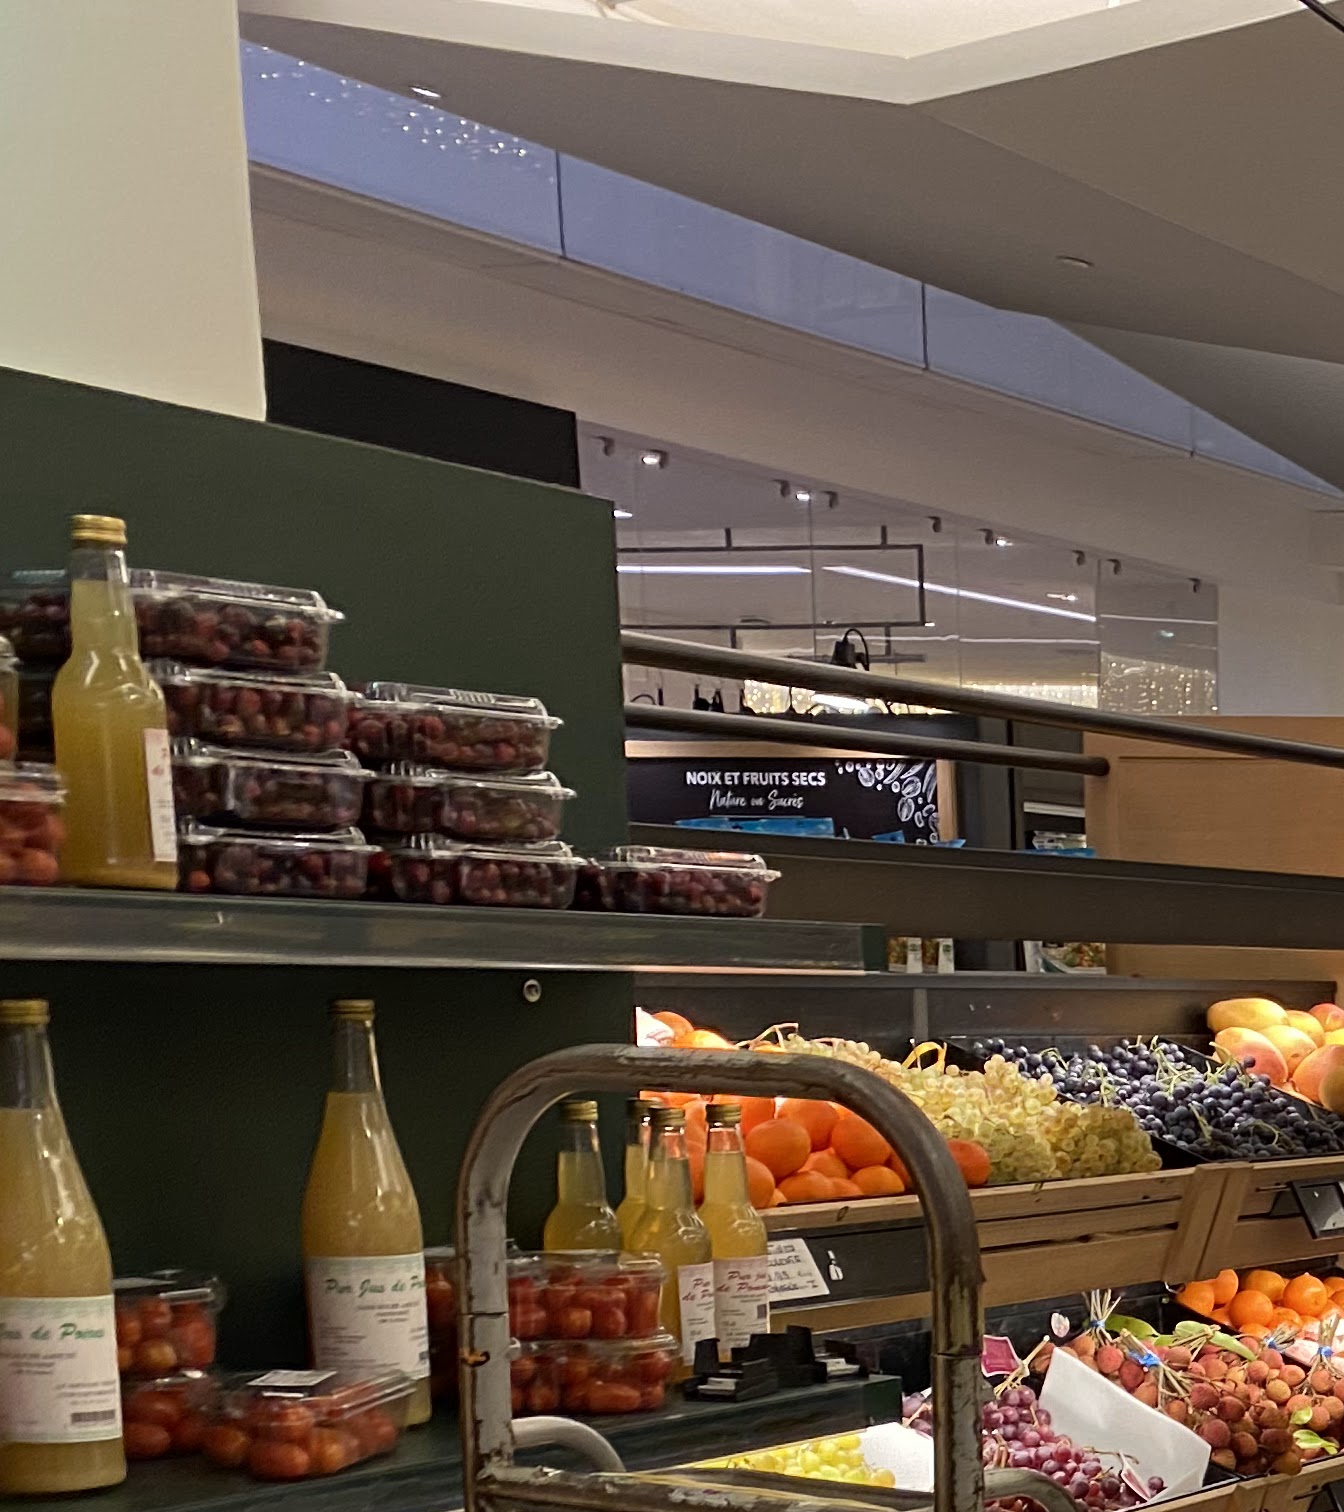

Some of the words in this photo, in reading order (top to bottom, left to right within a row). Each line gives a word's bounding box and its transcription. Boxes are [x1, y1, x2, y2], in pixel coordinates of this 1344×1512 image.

[686, 772, 721, 785] NOIX
[724, 772, 740, 785] ET
[743, 772, 789, 785] FRUITS
[792, 772, 826, 786] SECS
[709, 790, 746, 810] Nature
